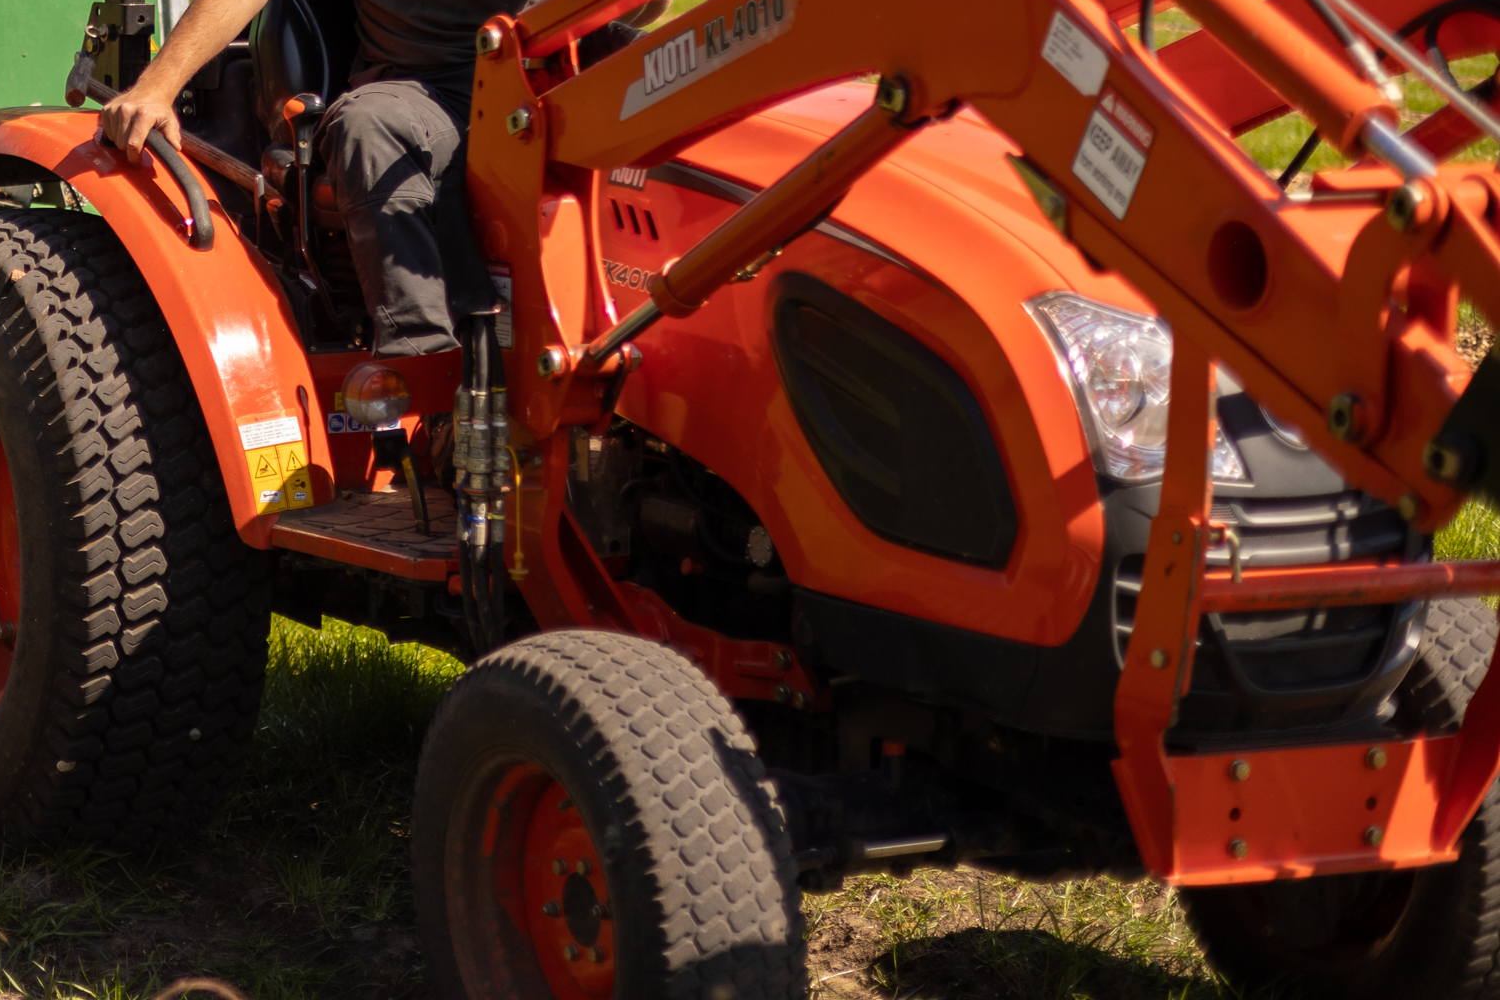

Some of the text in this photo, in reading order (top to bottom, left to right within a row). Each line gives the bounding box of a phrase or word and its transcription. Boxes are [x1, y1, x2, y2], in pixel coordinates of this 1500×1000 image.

[643, 28, 697, 96] KIOTI
[1088, 120, 1140, 182] KEEP AWAY
[1113, 102, 1153, 148] WARNING
